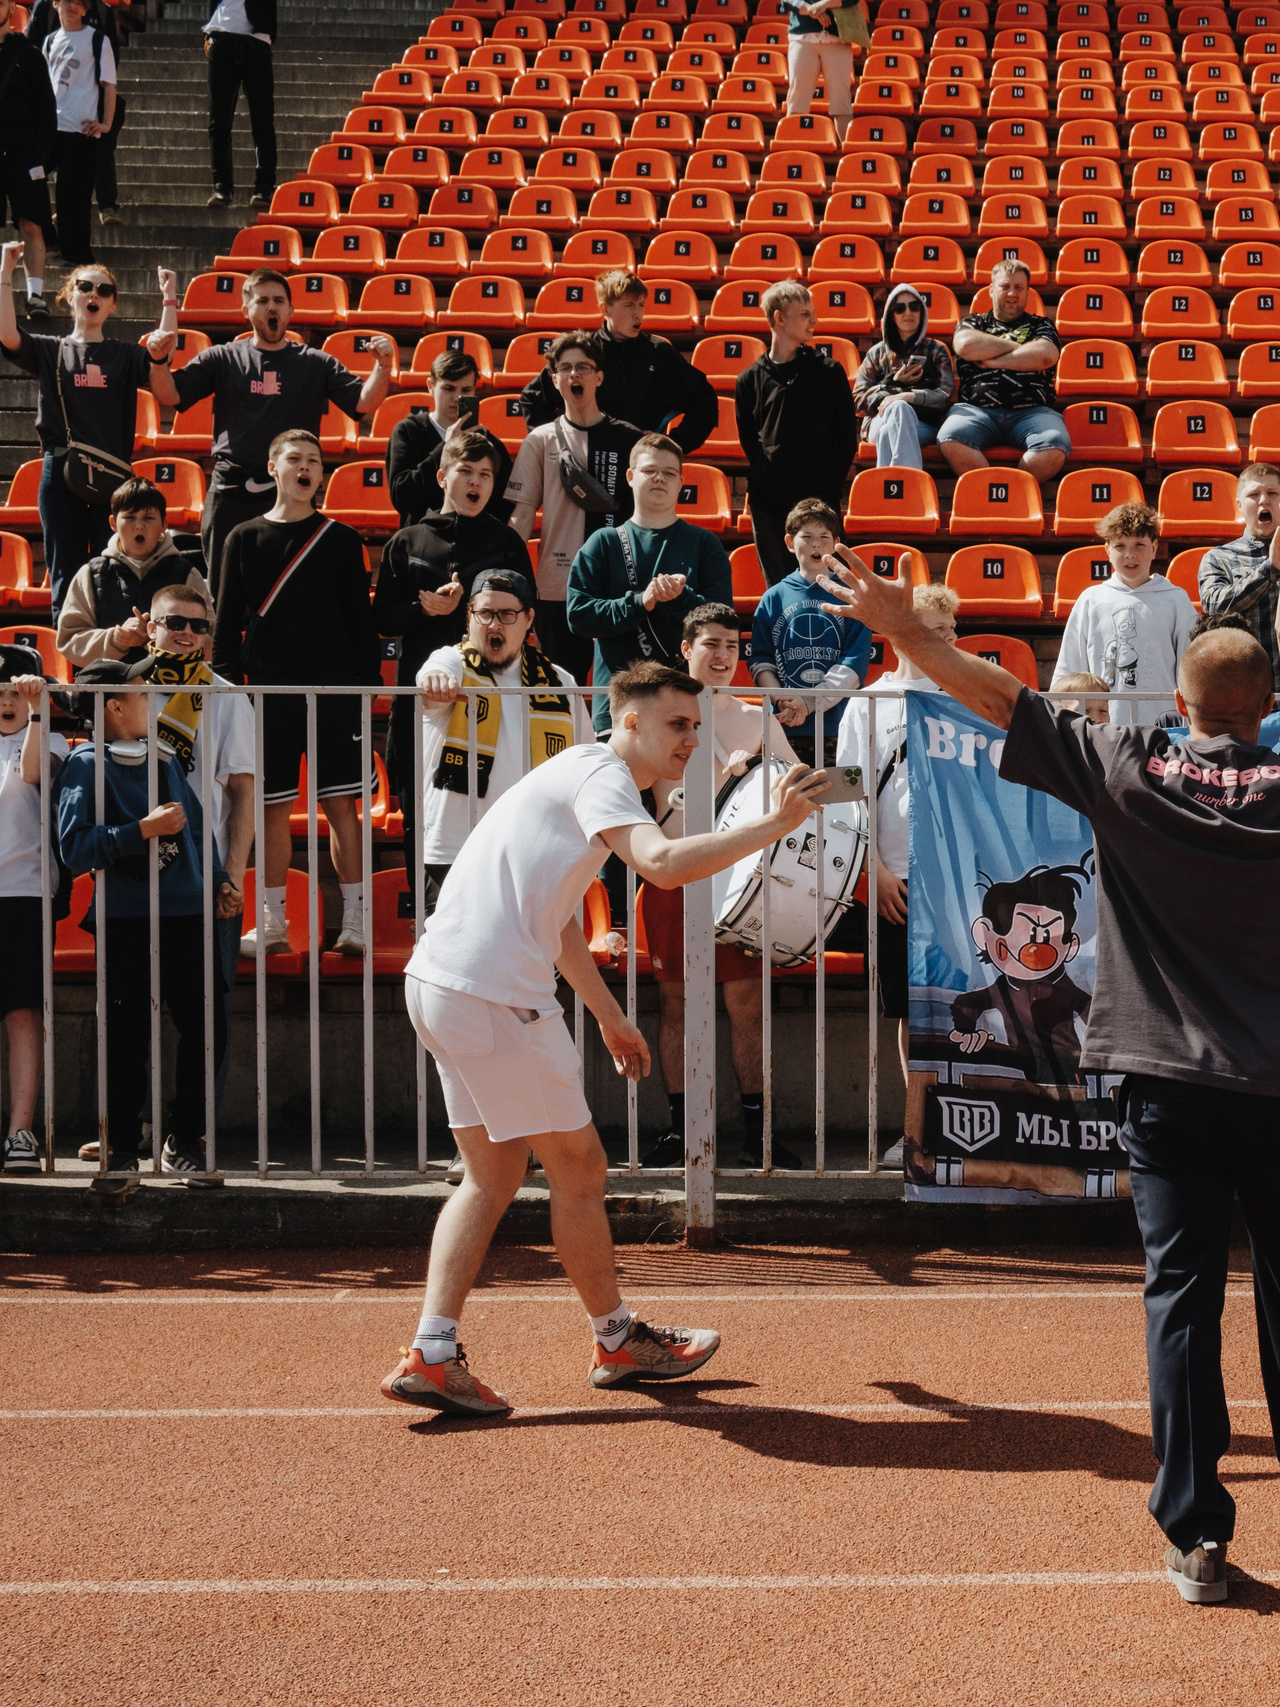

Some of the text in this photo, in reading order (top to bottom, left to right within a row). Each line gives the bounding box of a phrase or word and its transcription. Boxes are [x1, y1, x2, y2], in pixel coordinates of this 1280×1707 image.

[1218, 93, 1227, 101] 13
[1160, 170, 1170, 179] 12
[1008, 208, 1019, 217] 10
[1163, 204, 1173, 213] 12
[433, 235, 440, 244] 3
[516, 239, 523, 248] 4
[597, 242, 603, 252] 5
[844, 246, 851, 255] 8
[928, 249, 934, 258] 9
[1005, 251, 1016, 260] 10
[1171, 253, 1181, 262] 12
[399, 282, 406, 292] 3
[571, 289, 578, 299] 5
[659, 292, 666, 301] 6
[748, 294, 754, 304] 7
[1089, 298, 1099, 307] 11
[1175, 299, 1186, 309] 12
[359, 338, 367, 349] 3
[452, 339, 459, 350] 4
[543, 341, 550, 351] 5
[1182, 348, 1193, 358] 12
[512, 402, 519, 414] 5
[1093, 410, 1104, 421] 11
[1191, 419, 1203, 430] 12
[161, 467, 169, 479] 2
[369, 472, 377, 483] 4
[683, 489, 692, 500] 7
[890, 484, 897, 495] 9
[992, 487, 1006, 499] 10
[1096, 488, 1107, 499] 11
[1196, 486, 1209, 497] 12
[880, 560, 888, 572] 9
[987, 563, 1001, 575] 10
[1094, 565, 1108, 578] 11
[386, 643, 395, 656] 5
[175, 742, 191, 758] FC
[445, 752, 463, 766] BB
[1194, 790, 1266, 810] number one
[1015, 1111, 1071, 1148] МЫ
